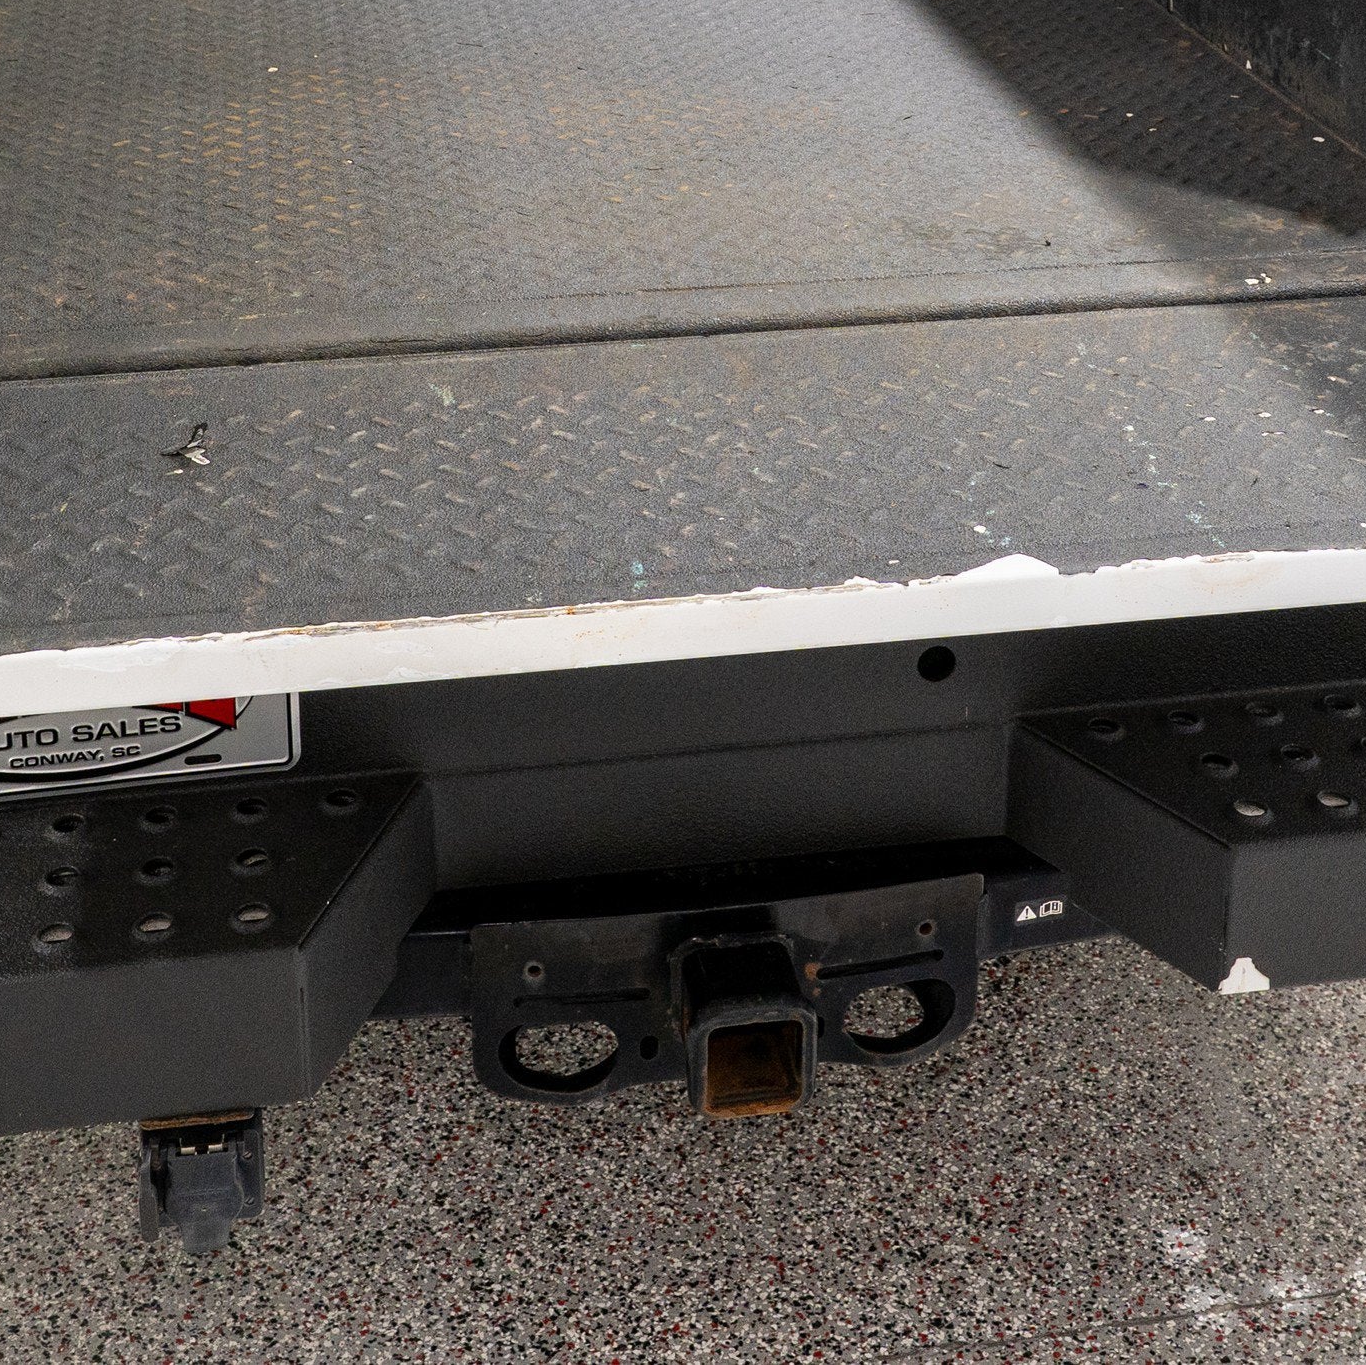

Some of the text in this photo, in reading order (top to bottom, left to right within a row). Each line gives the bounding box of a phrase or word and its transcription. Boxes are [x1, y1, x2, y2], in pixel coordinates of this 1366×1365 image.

[71, 715, 182, 743] SALES
[9, 745, 141, 769] CONWAY, SC
